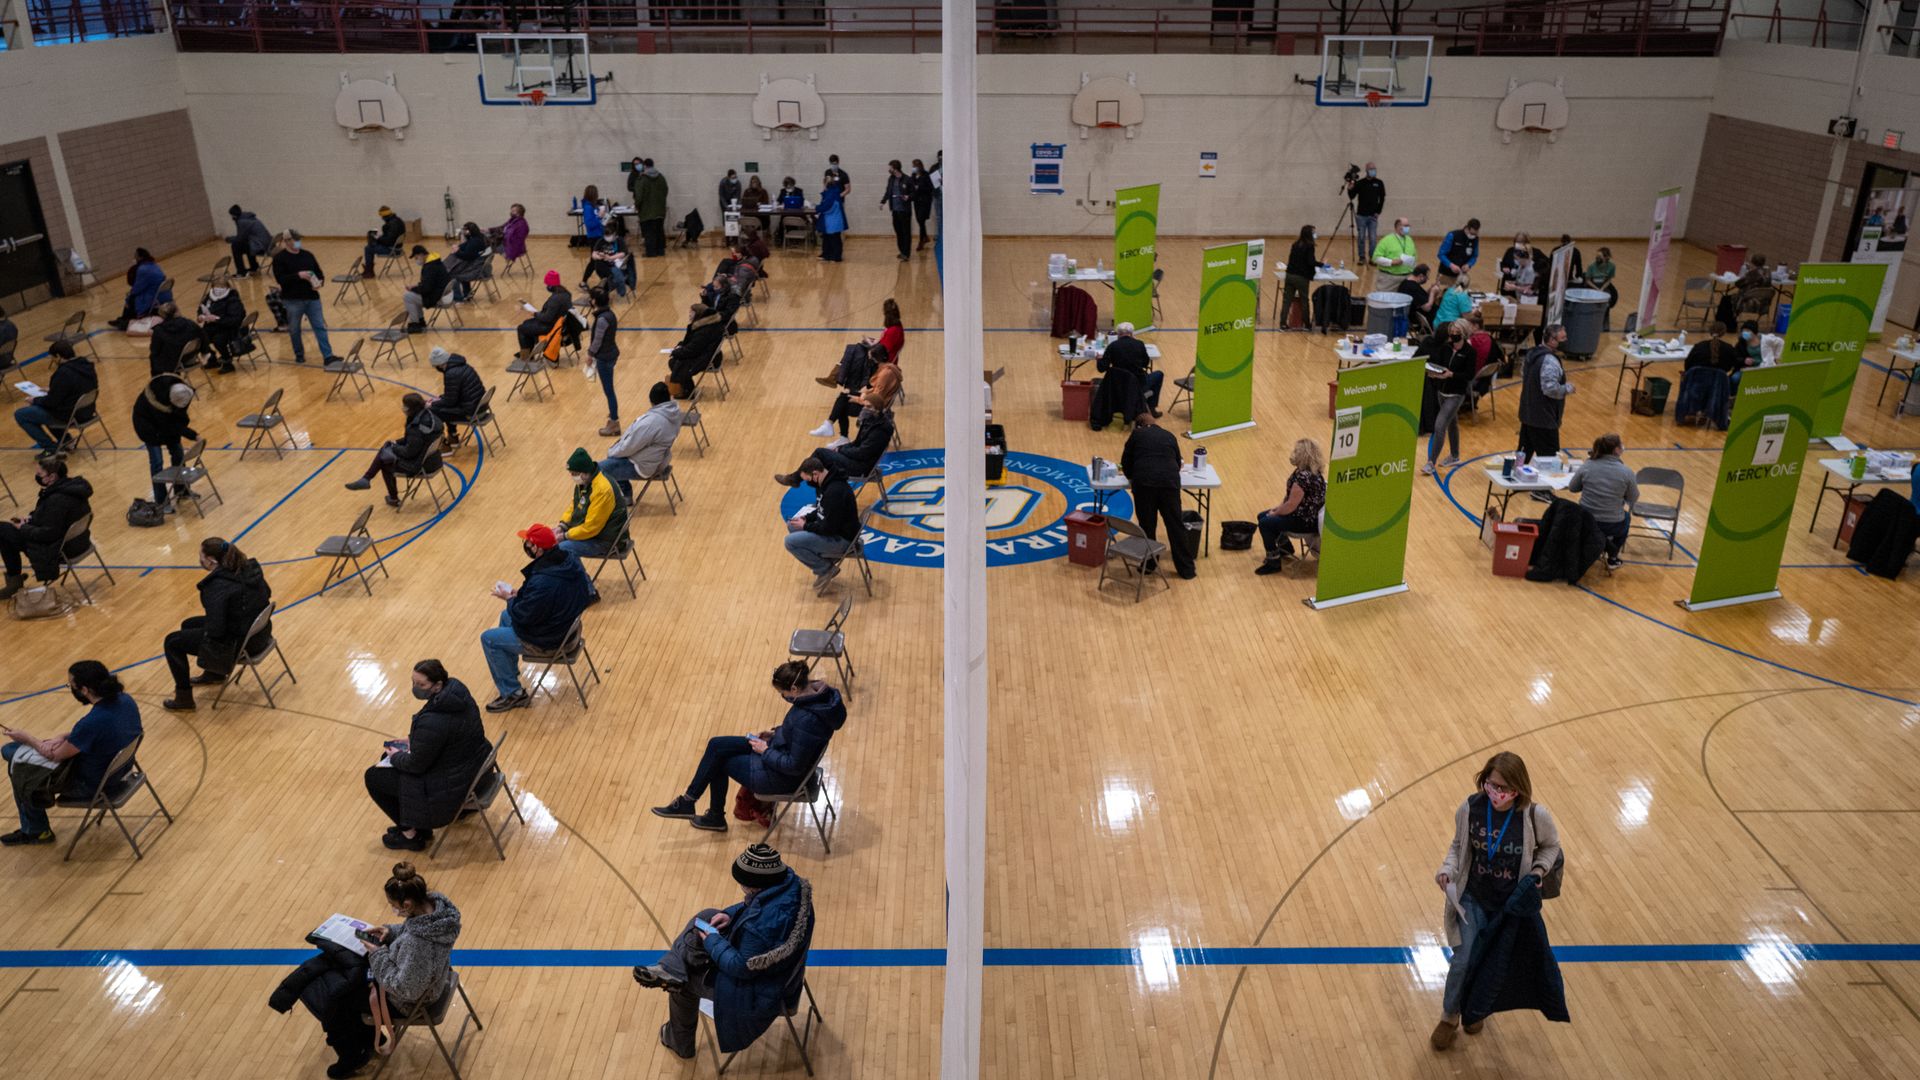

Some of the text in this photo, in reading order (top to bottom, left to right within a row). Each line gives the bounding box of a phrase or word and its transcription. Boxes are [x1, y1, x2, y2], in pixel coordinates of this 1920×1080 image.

[1864, 243, 1871, 252] 3
[1251, 259, 1258, 271] 9
[1803, 277, 1847, 285] Welcome to
[1204, 317, 1253, 335] MERCYONE
[1791, 340, 1859, 353] MERCYONE
[1344, 385, 1377, 395] Welcome
[1744, 383, 1788, 395] Welcome to
[1339, 433, 1354, 449] 10
[1765, 440, 1775, 454] 7
[1336, 459, 1409, 483] MERCYONE
[1726, 462, 1799, 483] MERCYONE
